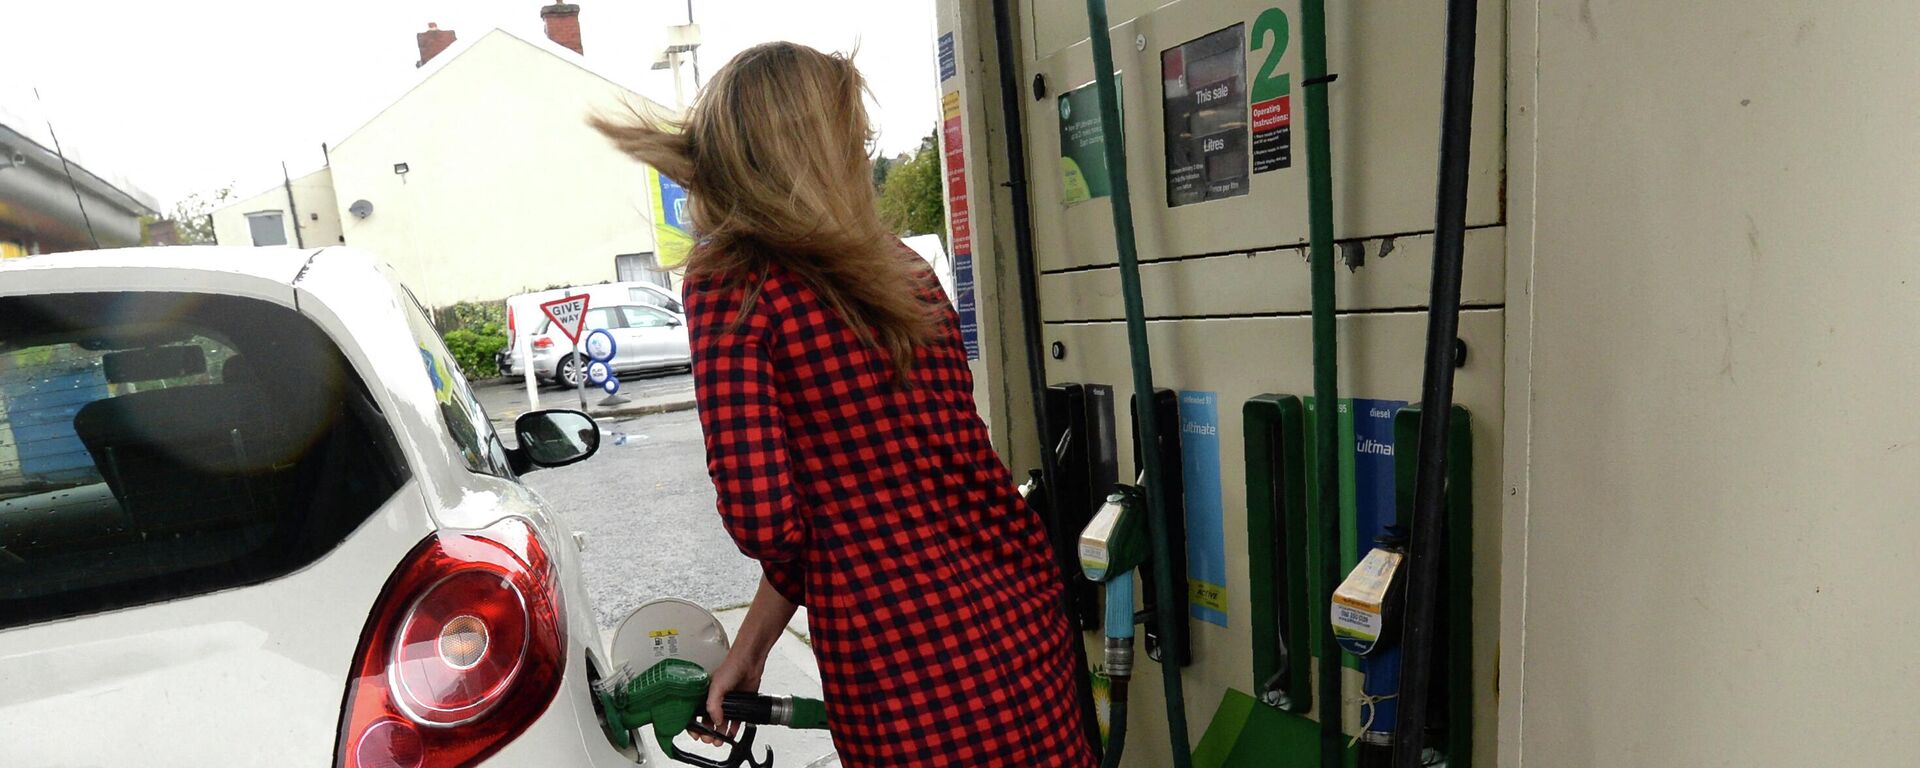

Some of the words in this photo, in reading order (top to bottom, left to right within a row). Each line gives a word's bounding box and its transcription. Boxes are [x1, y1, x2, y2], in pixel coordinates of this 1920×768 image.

[1250, 7, 1290, 104] 2
[1196, 90, 1212, 104] This
[1212, 85, 1229, 99] sale
[1253, 104, 1281, 117] Operating
[1253, 113, 1289, 128] Instructions:
[1203, 138, 1225, 152] Litres
[1222, 183, 1231, 192] per
[552, 301, 581, 316] GIVE
[560, 313, 580, 324] WAY
[1338, 404, 1347, 413] 95
[1369, 407, 1391, 418] diesel
[1183, 422, 1216, 435] ultimate
[1357, 440, 1394, 455] ultima
